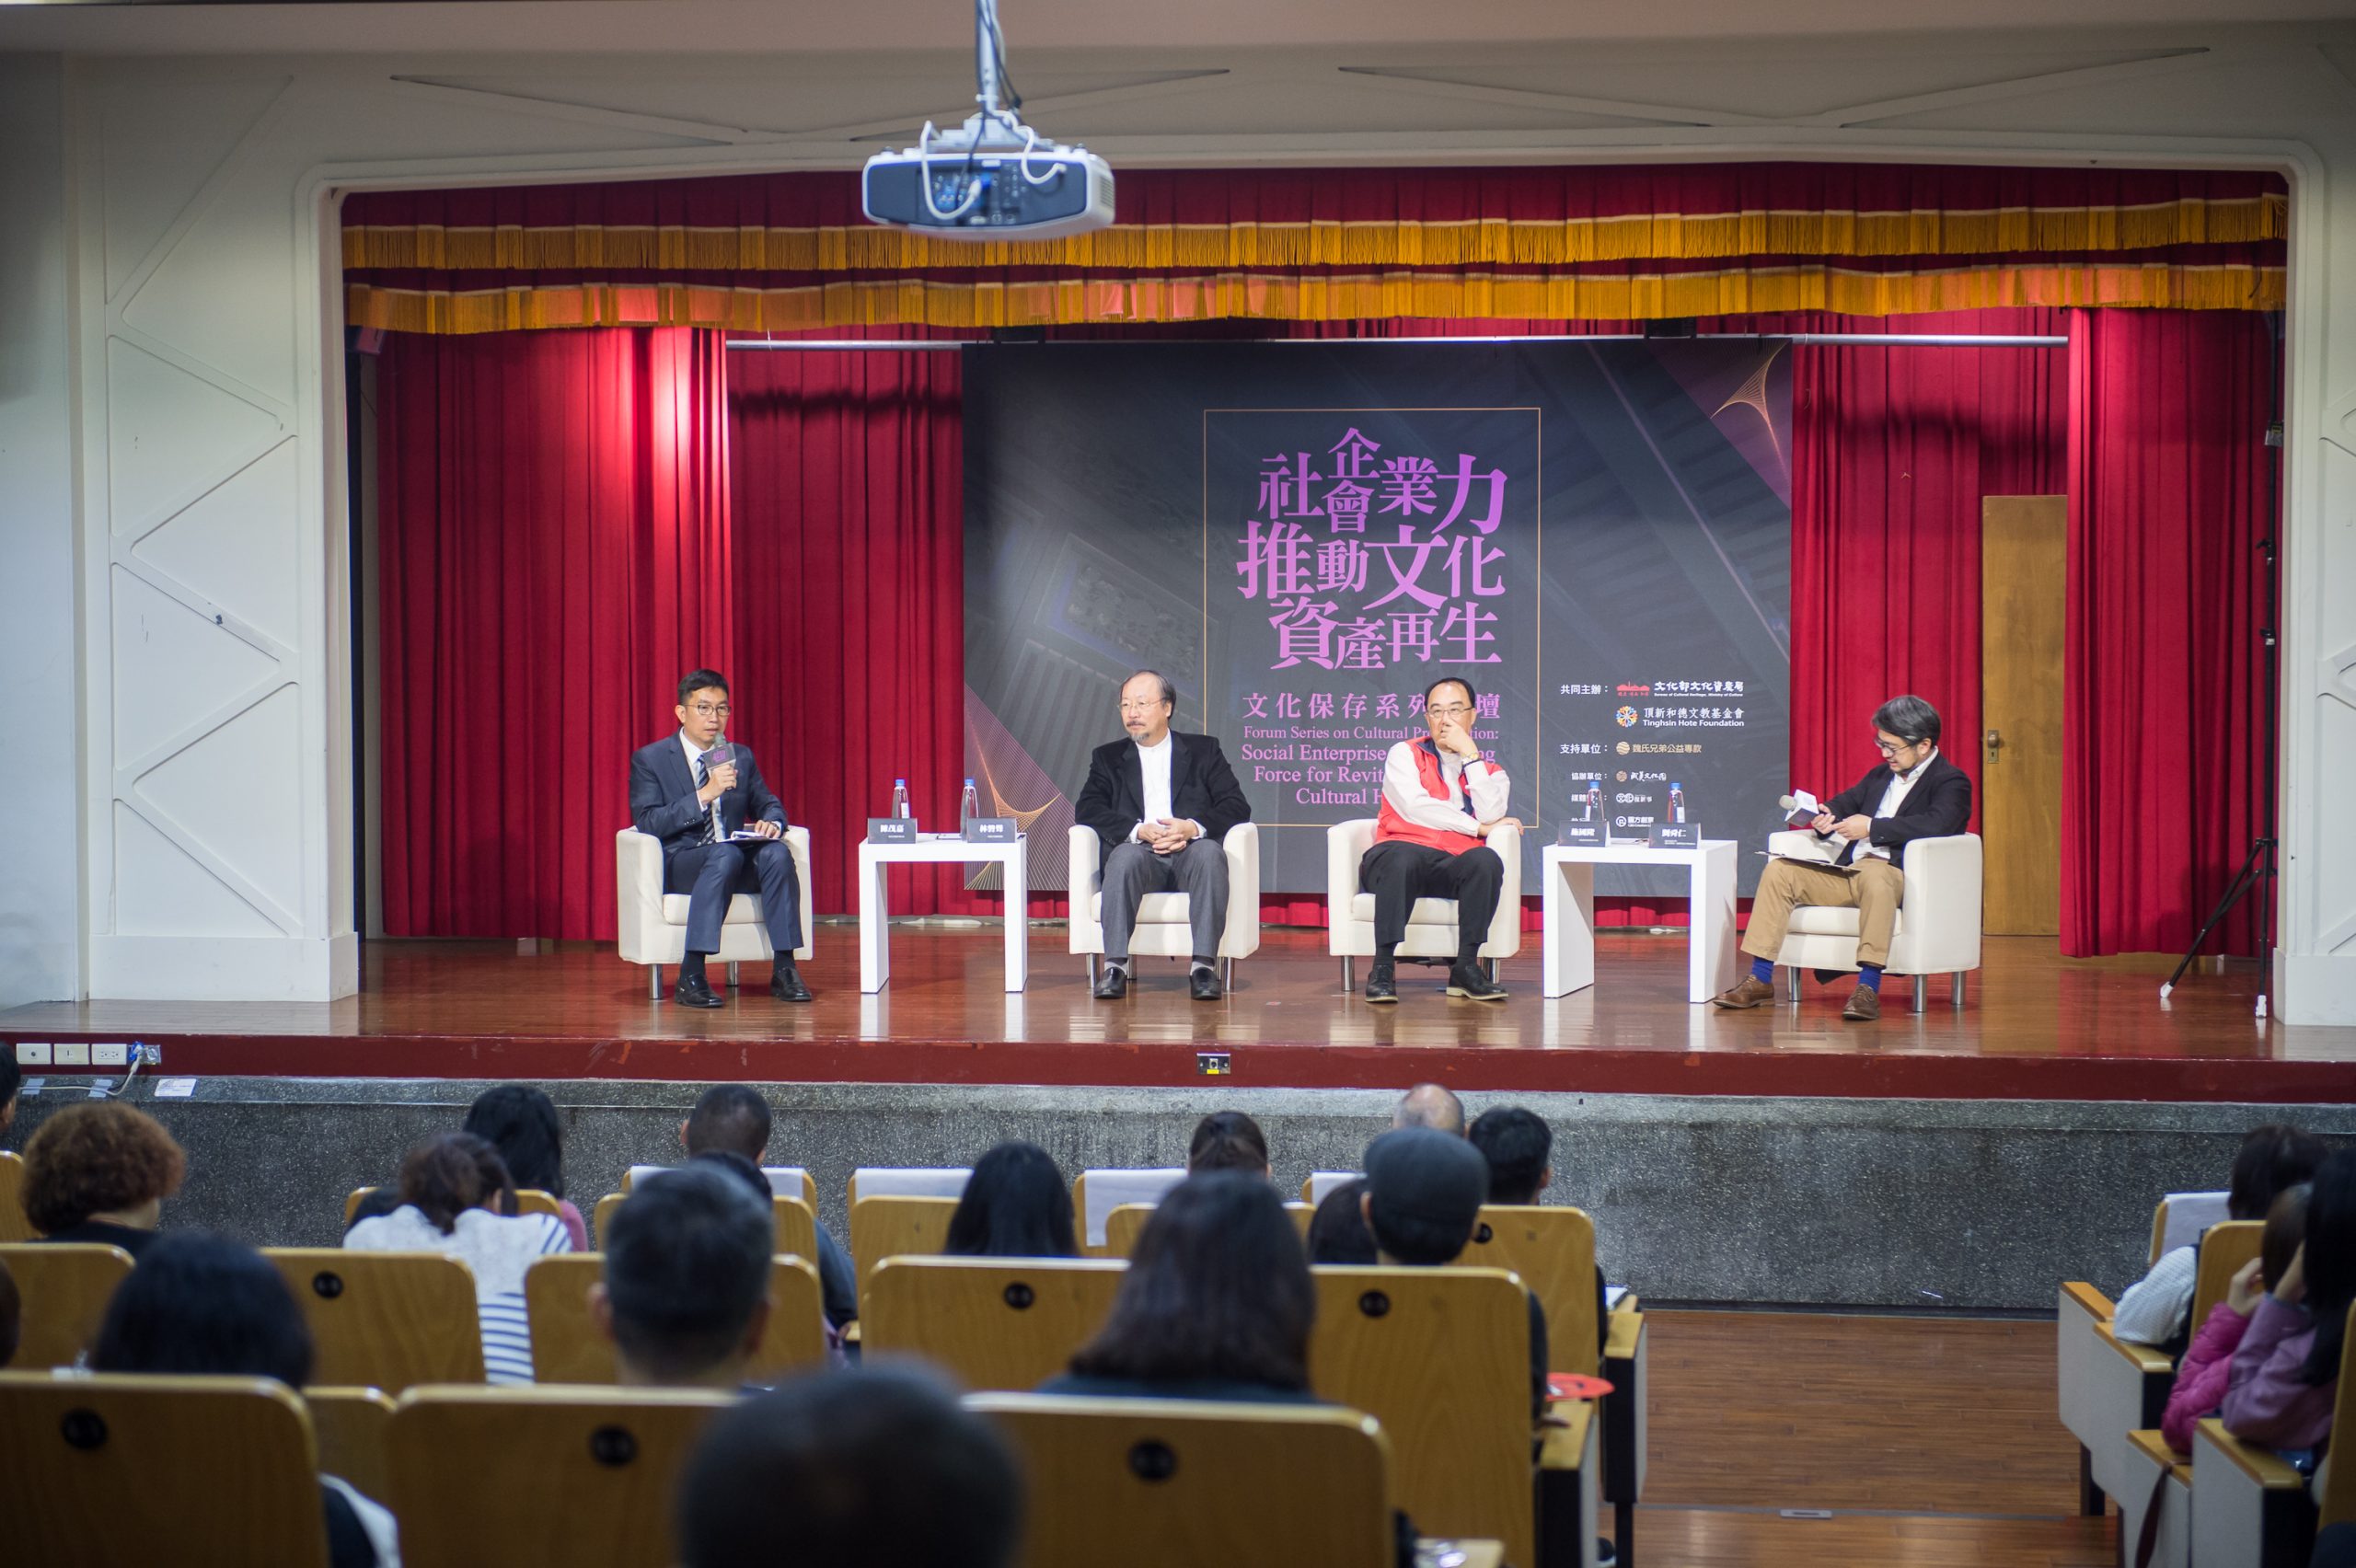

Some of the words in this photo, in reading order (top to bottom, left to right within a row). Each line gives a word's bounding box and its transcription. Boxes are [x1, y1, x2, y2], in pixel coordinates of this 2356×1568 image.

[1236, 520, 1507, 610] 推動文化
[1268, 596, 1503, 670] 資產再生
[1242, 693, 1500, 720] 文化保存系列壇
[1644, 707, 1744, 719] 頂新和德文教基金會
[1643, 719, 1677, 727] Tinghsin
[1243, 726, 1287, 739] Forum
[1290, 725, 1330, 739] Series
[1333, 729, 1349, 739] on
[1353, 725, 1408, 739] Cultural
[1242, 744, 1294, 762] Social
[1299, 744, 1386, 765] Enterprise
[1253, 766, 1301, 782] Force
[1307, 766, 1334, 782] for
[1295, 788, 1368, 804] Cultural
